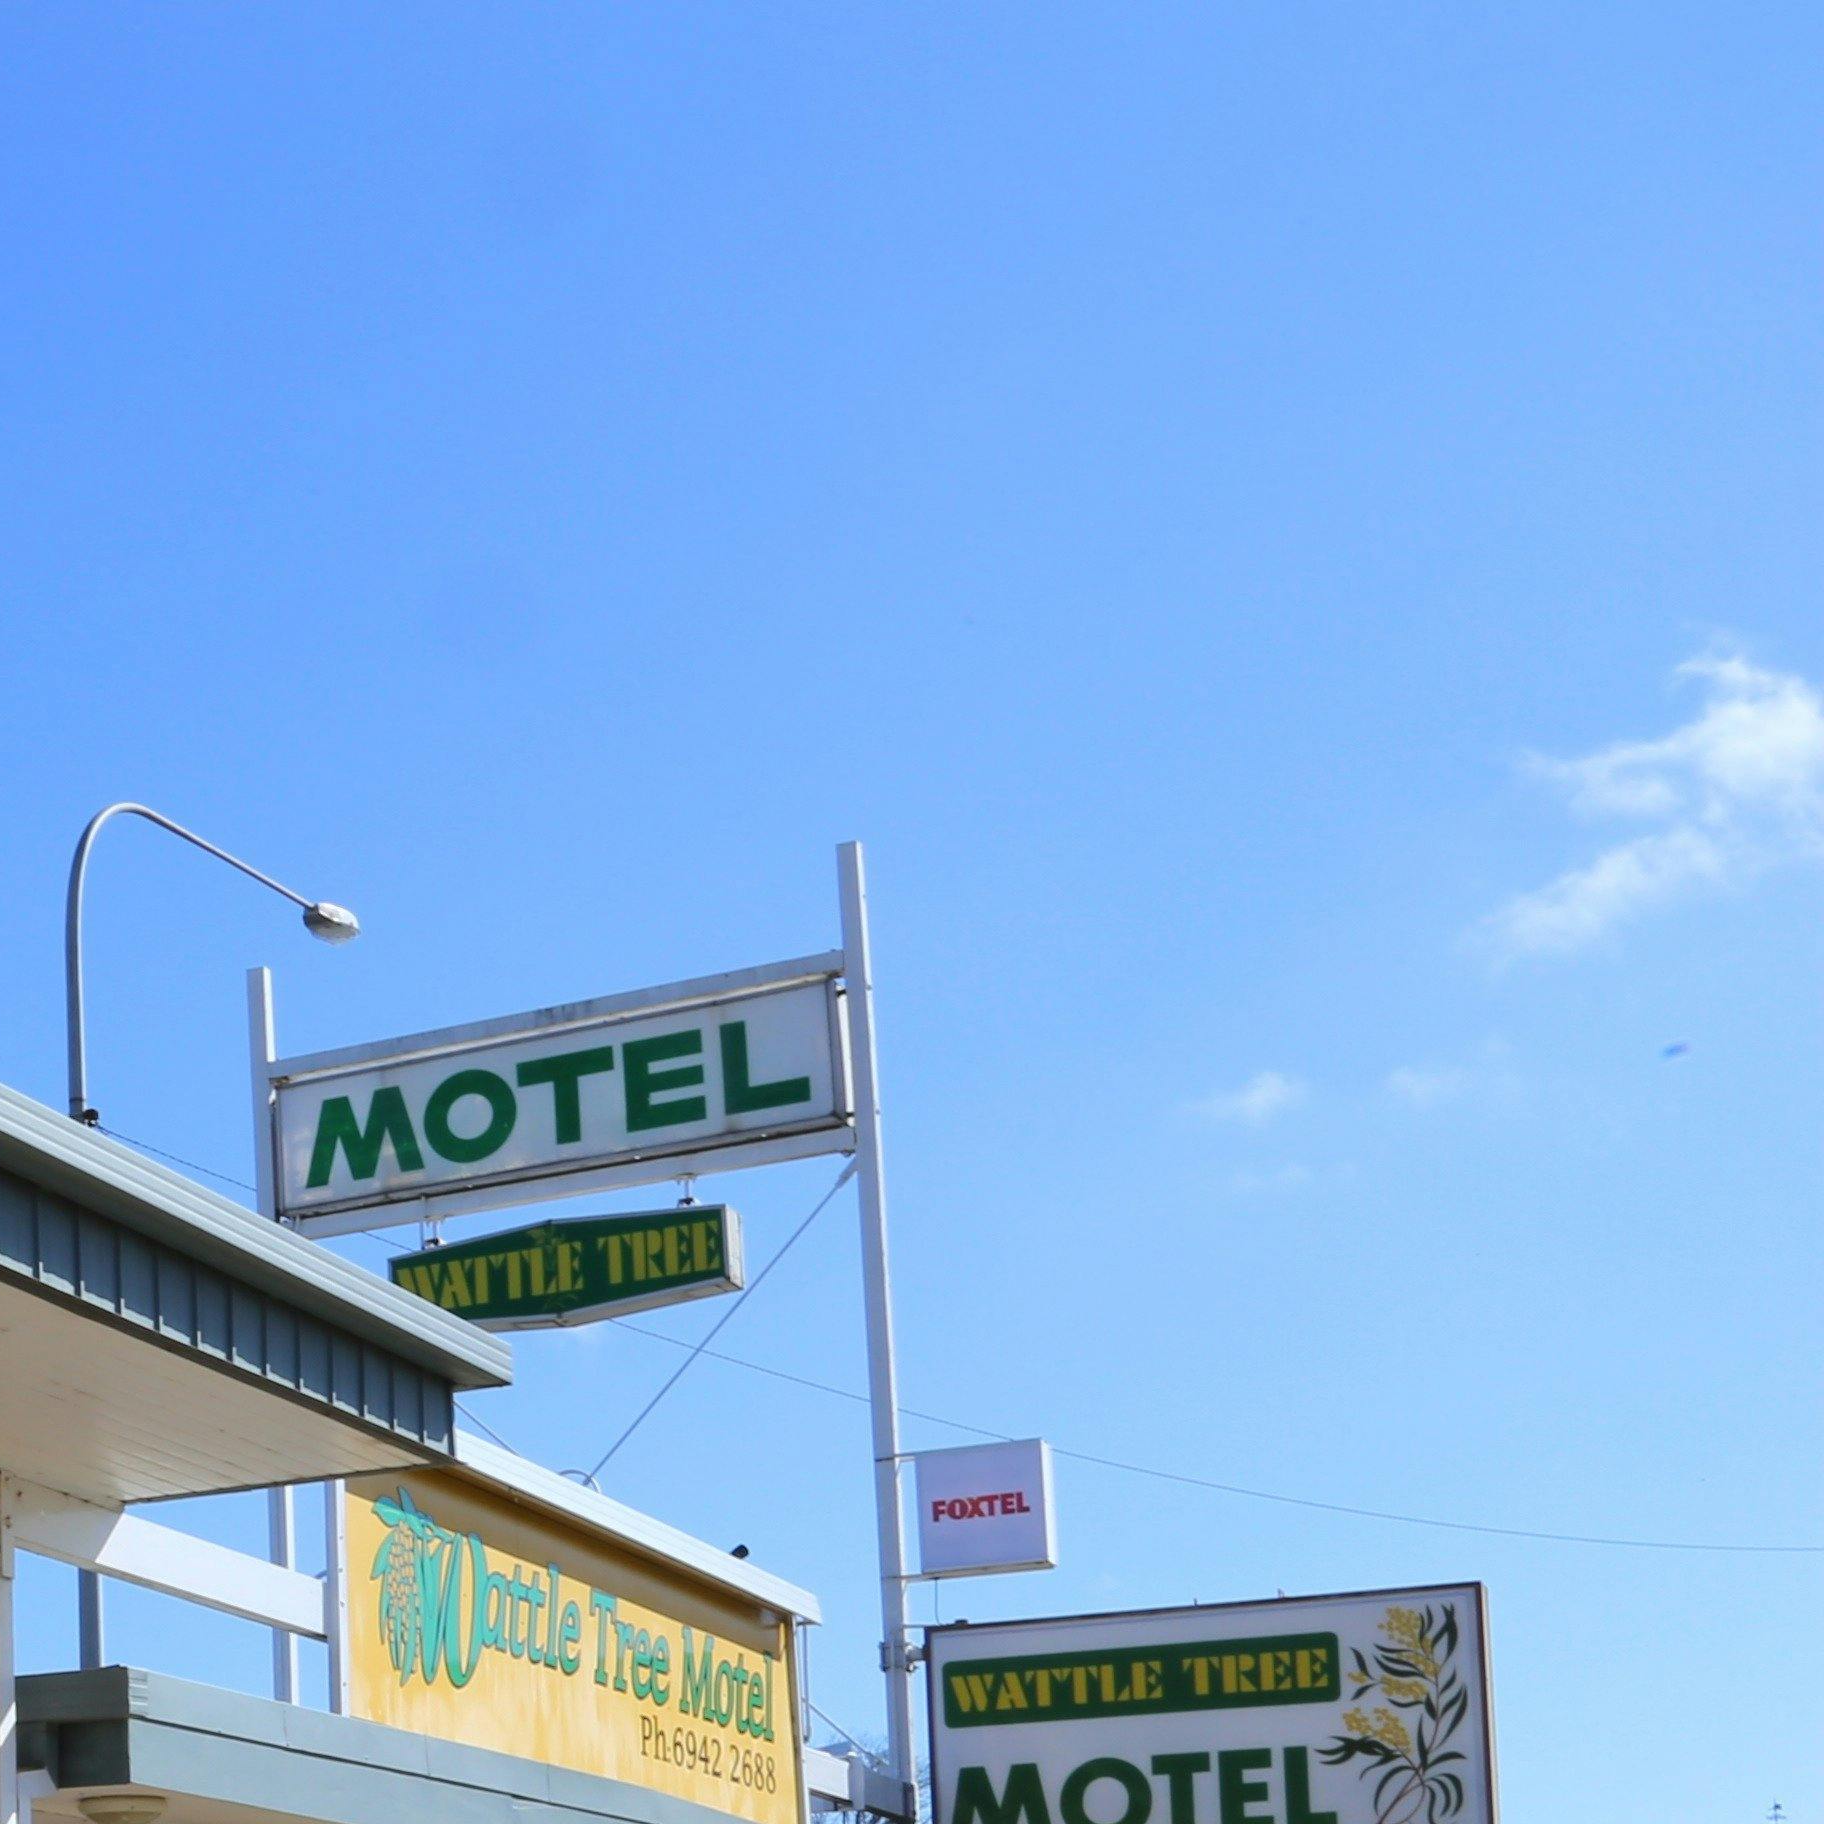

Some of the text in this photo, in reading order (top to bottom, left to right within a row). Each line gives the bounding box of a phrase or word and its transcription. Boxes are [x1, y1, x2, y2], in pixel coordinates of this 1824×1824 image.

[305, 1020, 811, 1189] MOTEL
[395, 1220, 720, 1307] WATTLE TREE
[932, 1491, 1031, 1523] FOXTEL
[418, 1532, 775, 1742] Wattle Tree Motel
[951, 1648, 1330, 1713] WATTLE TREE
[729, 1744, 777, 1794] 2688
